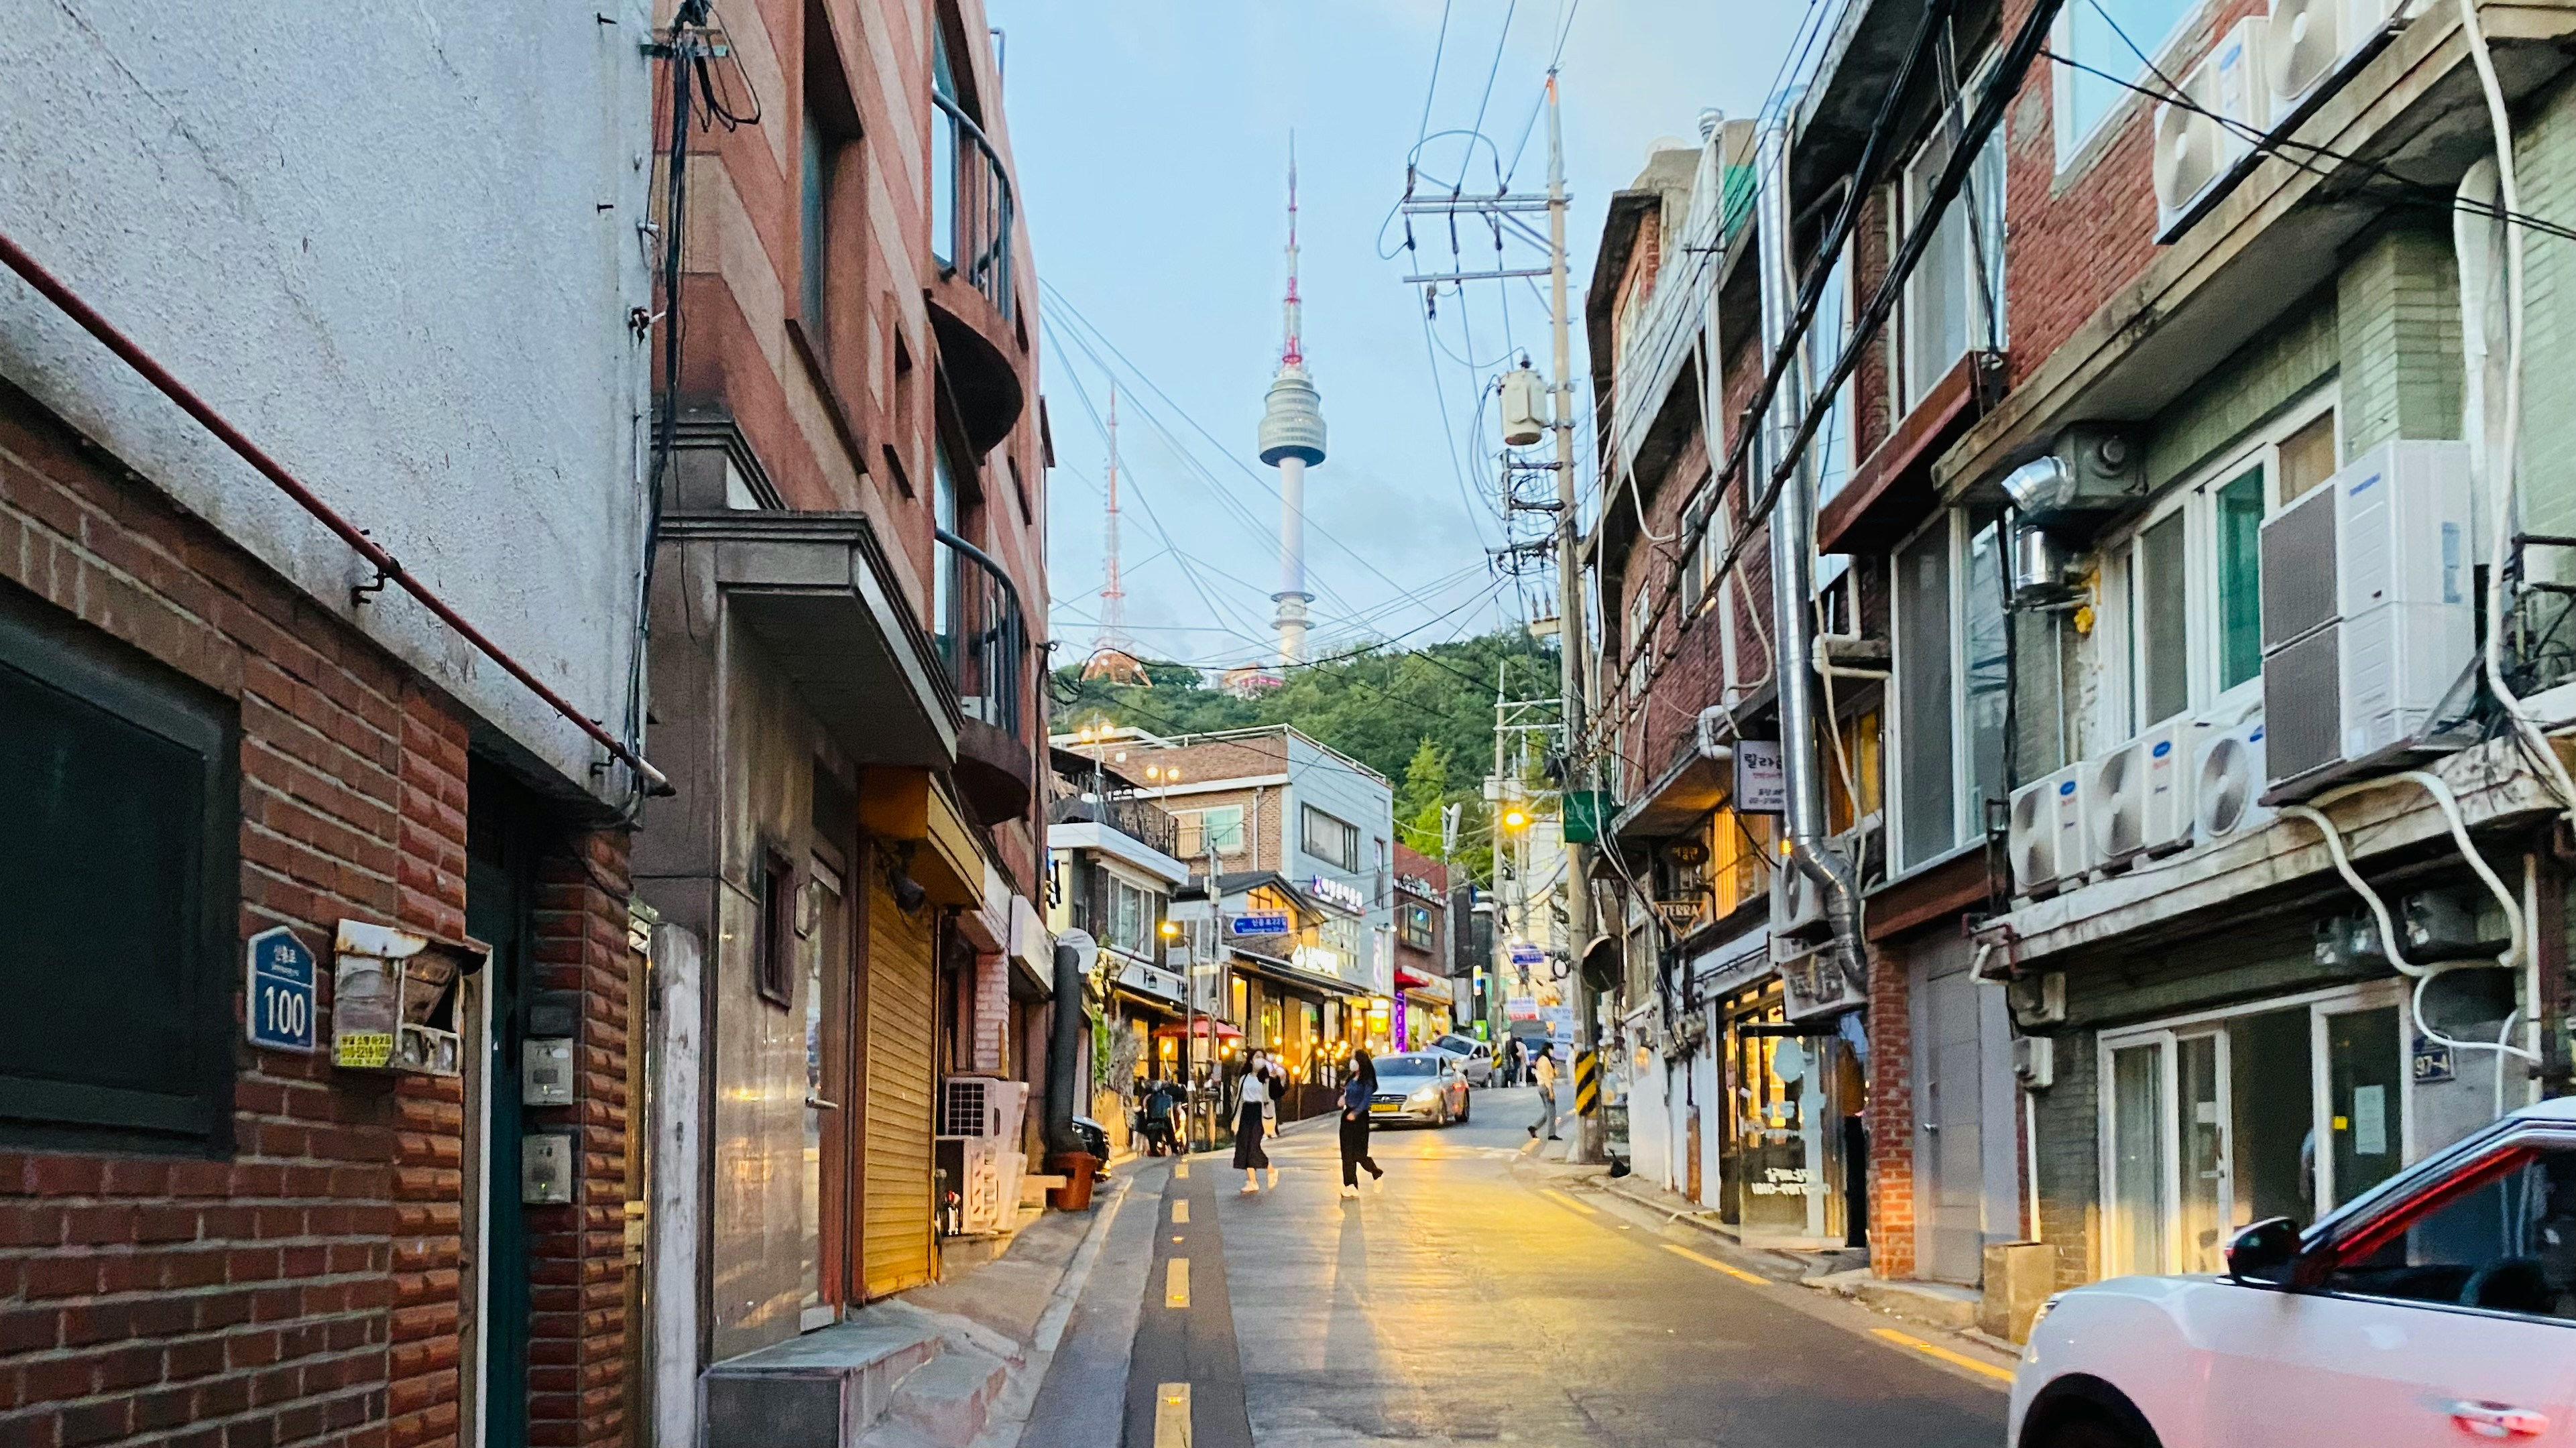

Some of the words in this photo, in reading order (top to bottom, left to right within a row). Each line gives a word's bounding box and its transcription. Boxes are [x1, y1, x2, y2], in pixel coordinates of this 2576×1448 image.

[1661, 904, 1701, 918] TERRA
[264, 985, 306, 1038] 100
[2415, 1053, 2449, 1076] 97-4
